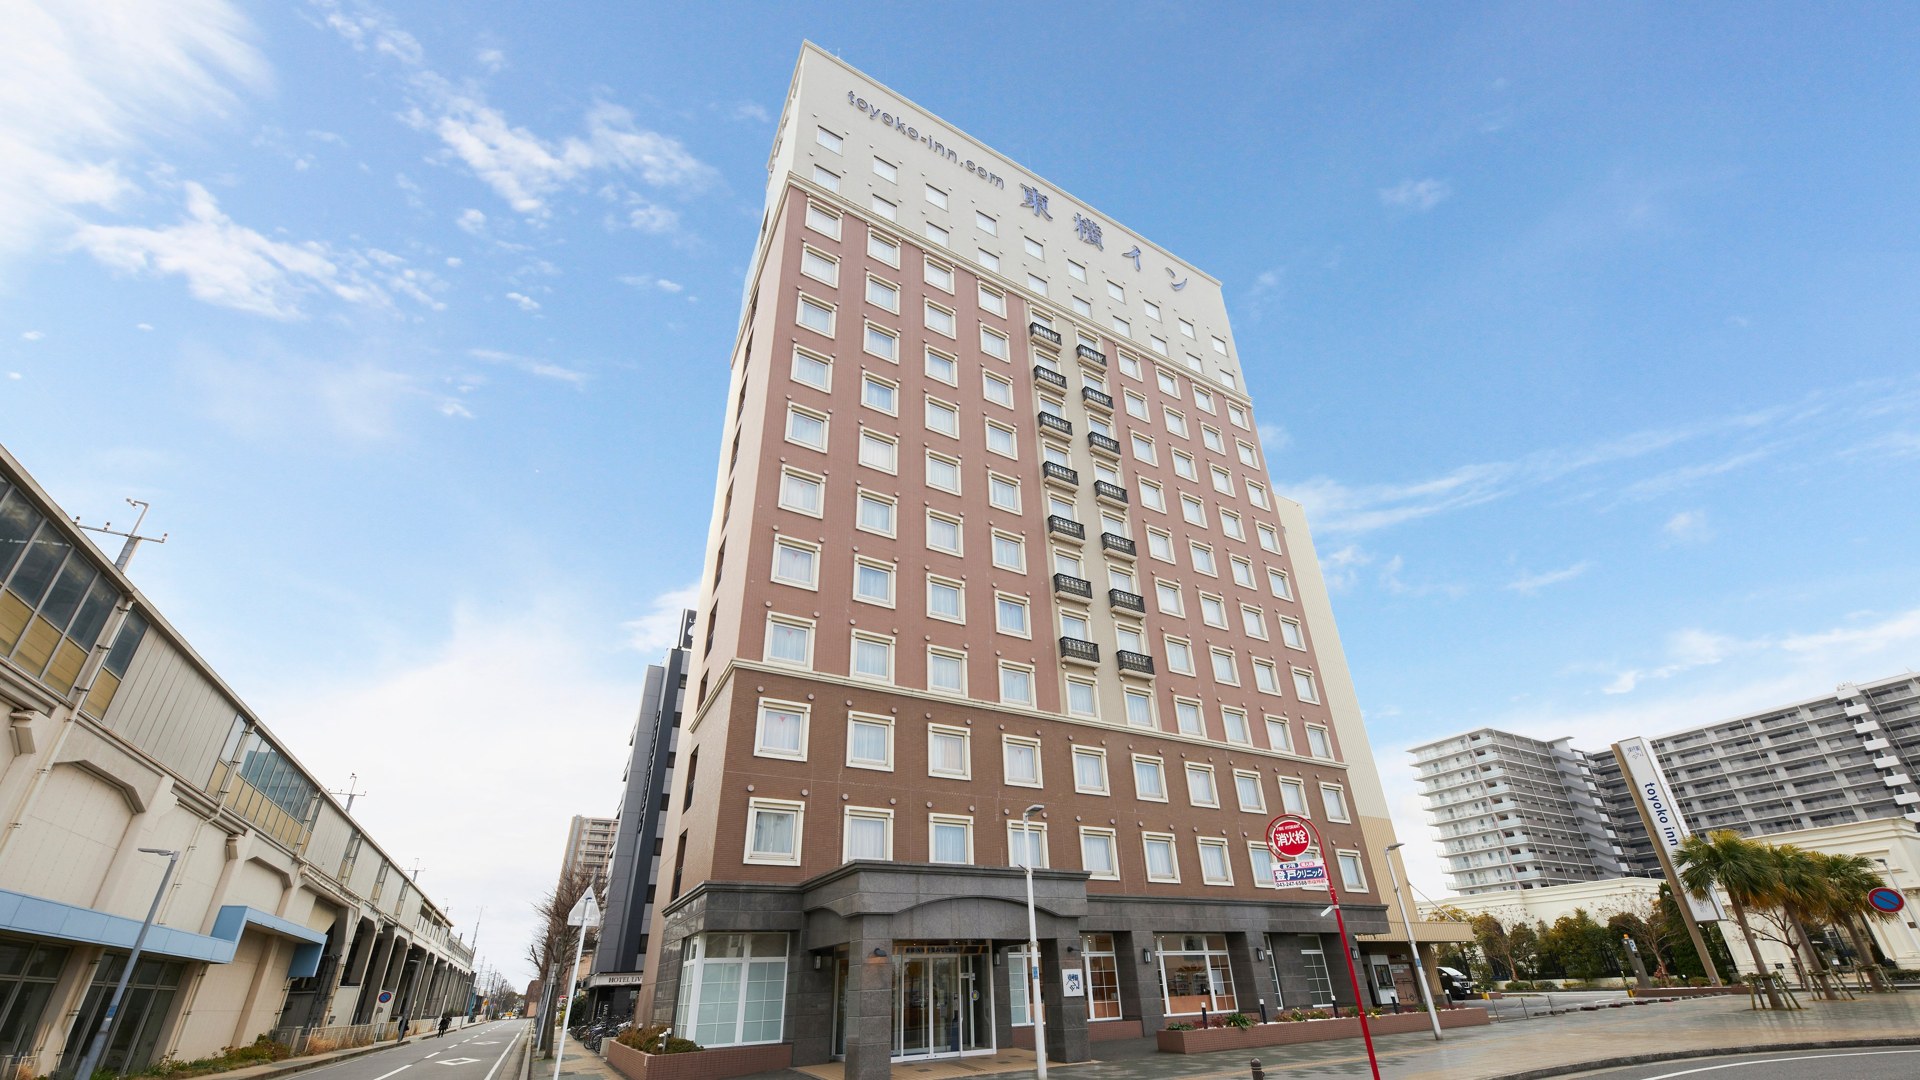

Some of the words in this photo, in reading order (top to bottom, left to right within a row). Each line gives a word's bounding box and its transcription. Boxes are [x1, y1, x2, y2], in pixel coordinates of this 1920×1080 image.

[847, 90, 1005, 191] toyoko-inn.com
[1020, 182, 1188, 292] 東横イン
[1275, 829, 1307, 846] 消火栓
[1645, 782, 1668, 823] toyoko
[1664, 827, 1678, 846] inn
[1275, 868, 1323, 881] 登戸クリニック
